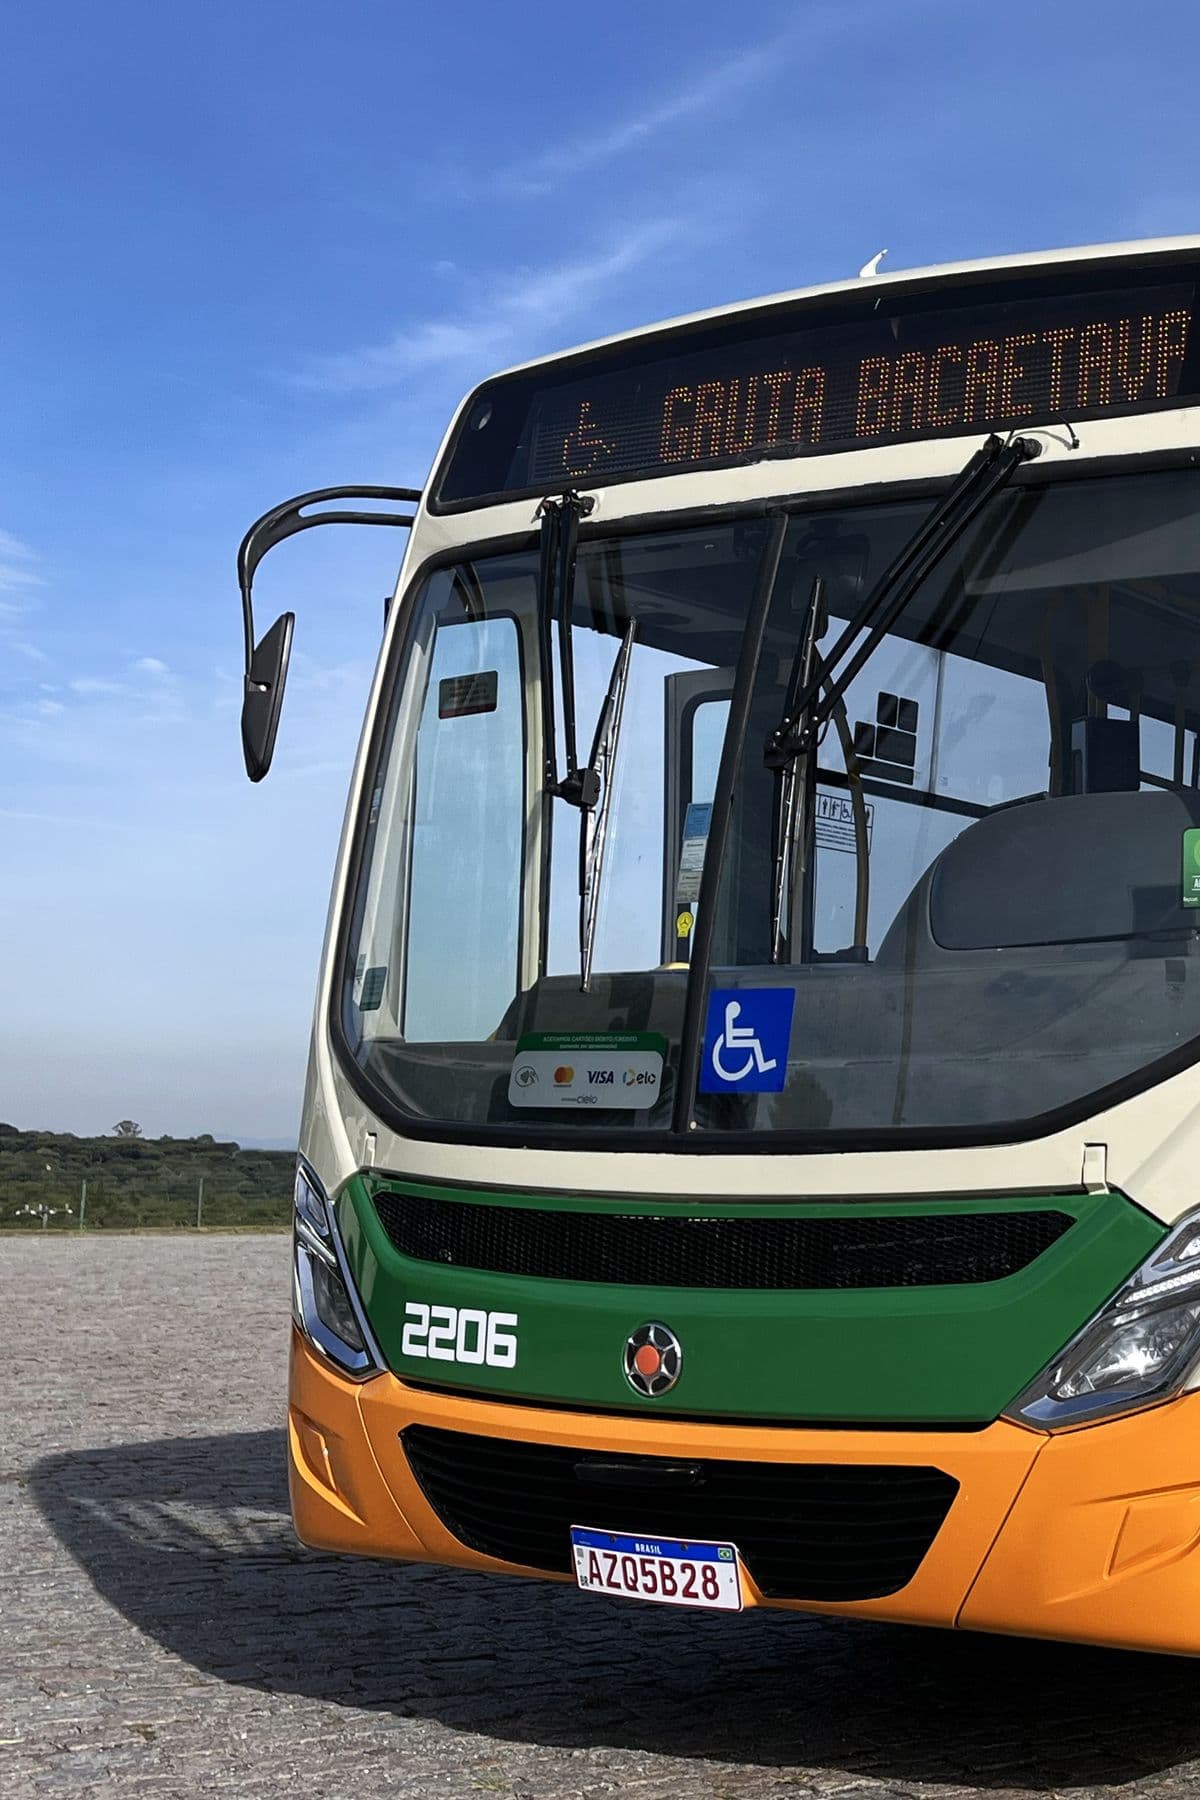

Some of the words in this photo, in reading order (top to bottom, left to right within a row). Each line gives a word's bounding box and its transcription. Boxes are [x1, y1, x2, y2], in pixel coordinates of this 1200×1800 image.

[660, 366, 825, 463] GRUTA
[587, 1070, 614, 1084] VISA
[401, 1302, 518, 1369] 2206
[635, 1543, 662, 1555] BRASIL
[588, 1550, 720, 1600] AZQ5B28
